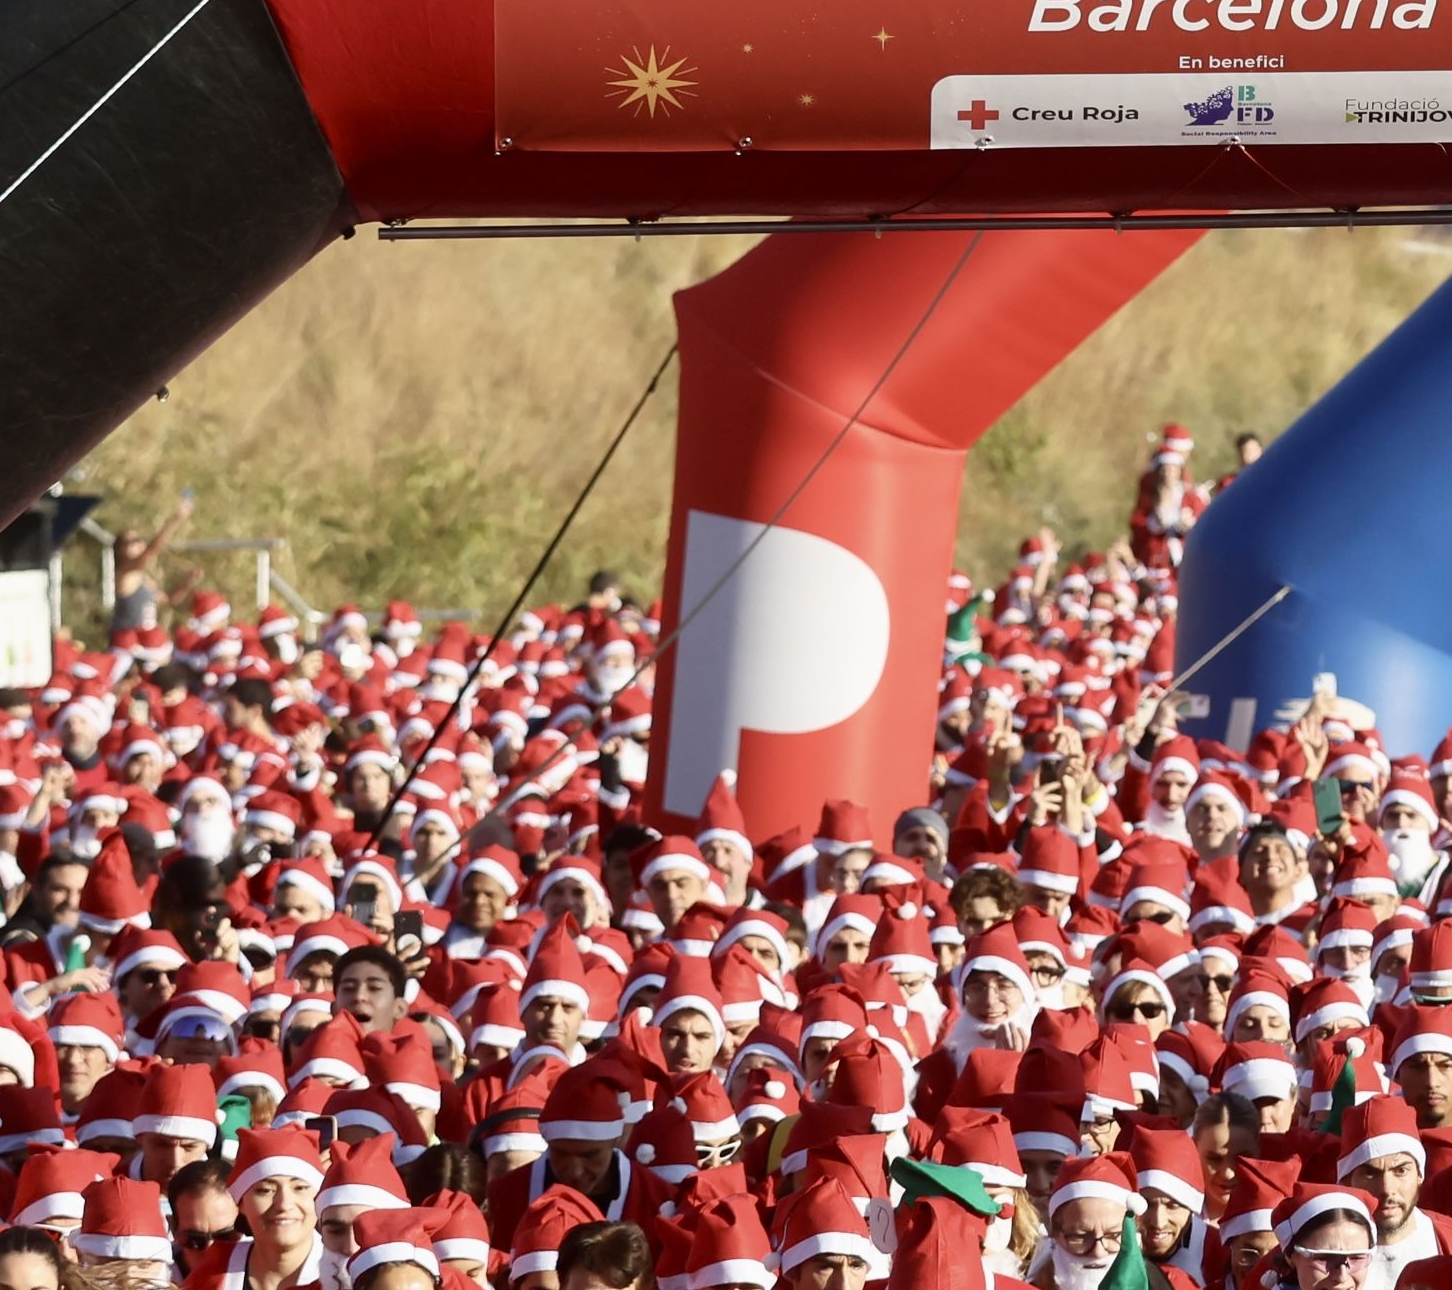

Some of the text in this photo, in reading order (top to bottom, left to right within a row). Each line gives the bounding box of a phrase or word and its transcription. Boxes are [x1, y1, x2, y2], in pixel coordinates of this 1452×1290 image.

[1179, 55, 1285, 69] En benefici
[1346, 97, 1439, 112] Fundació
[1012, 105, 1139, 123] Creu Roja
